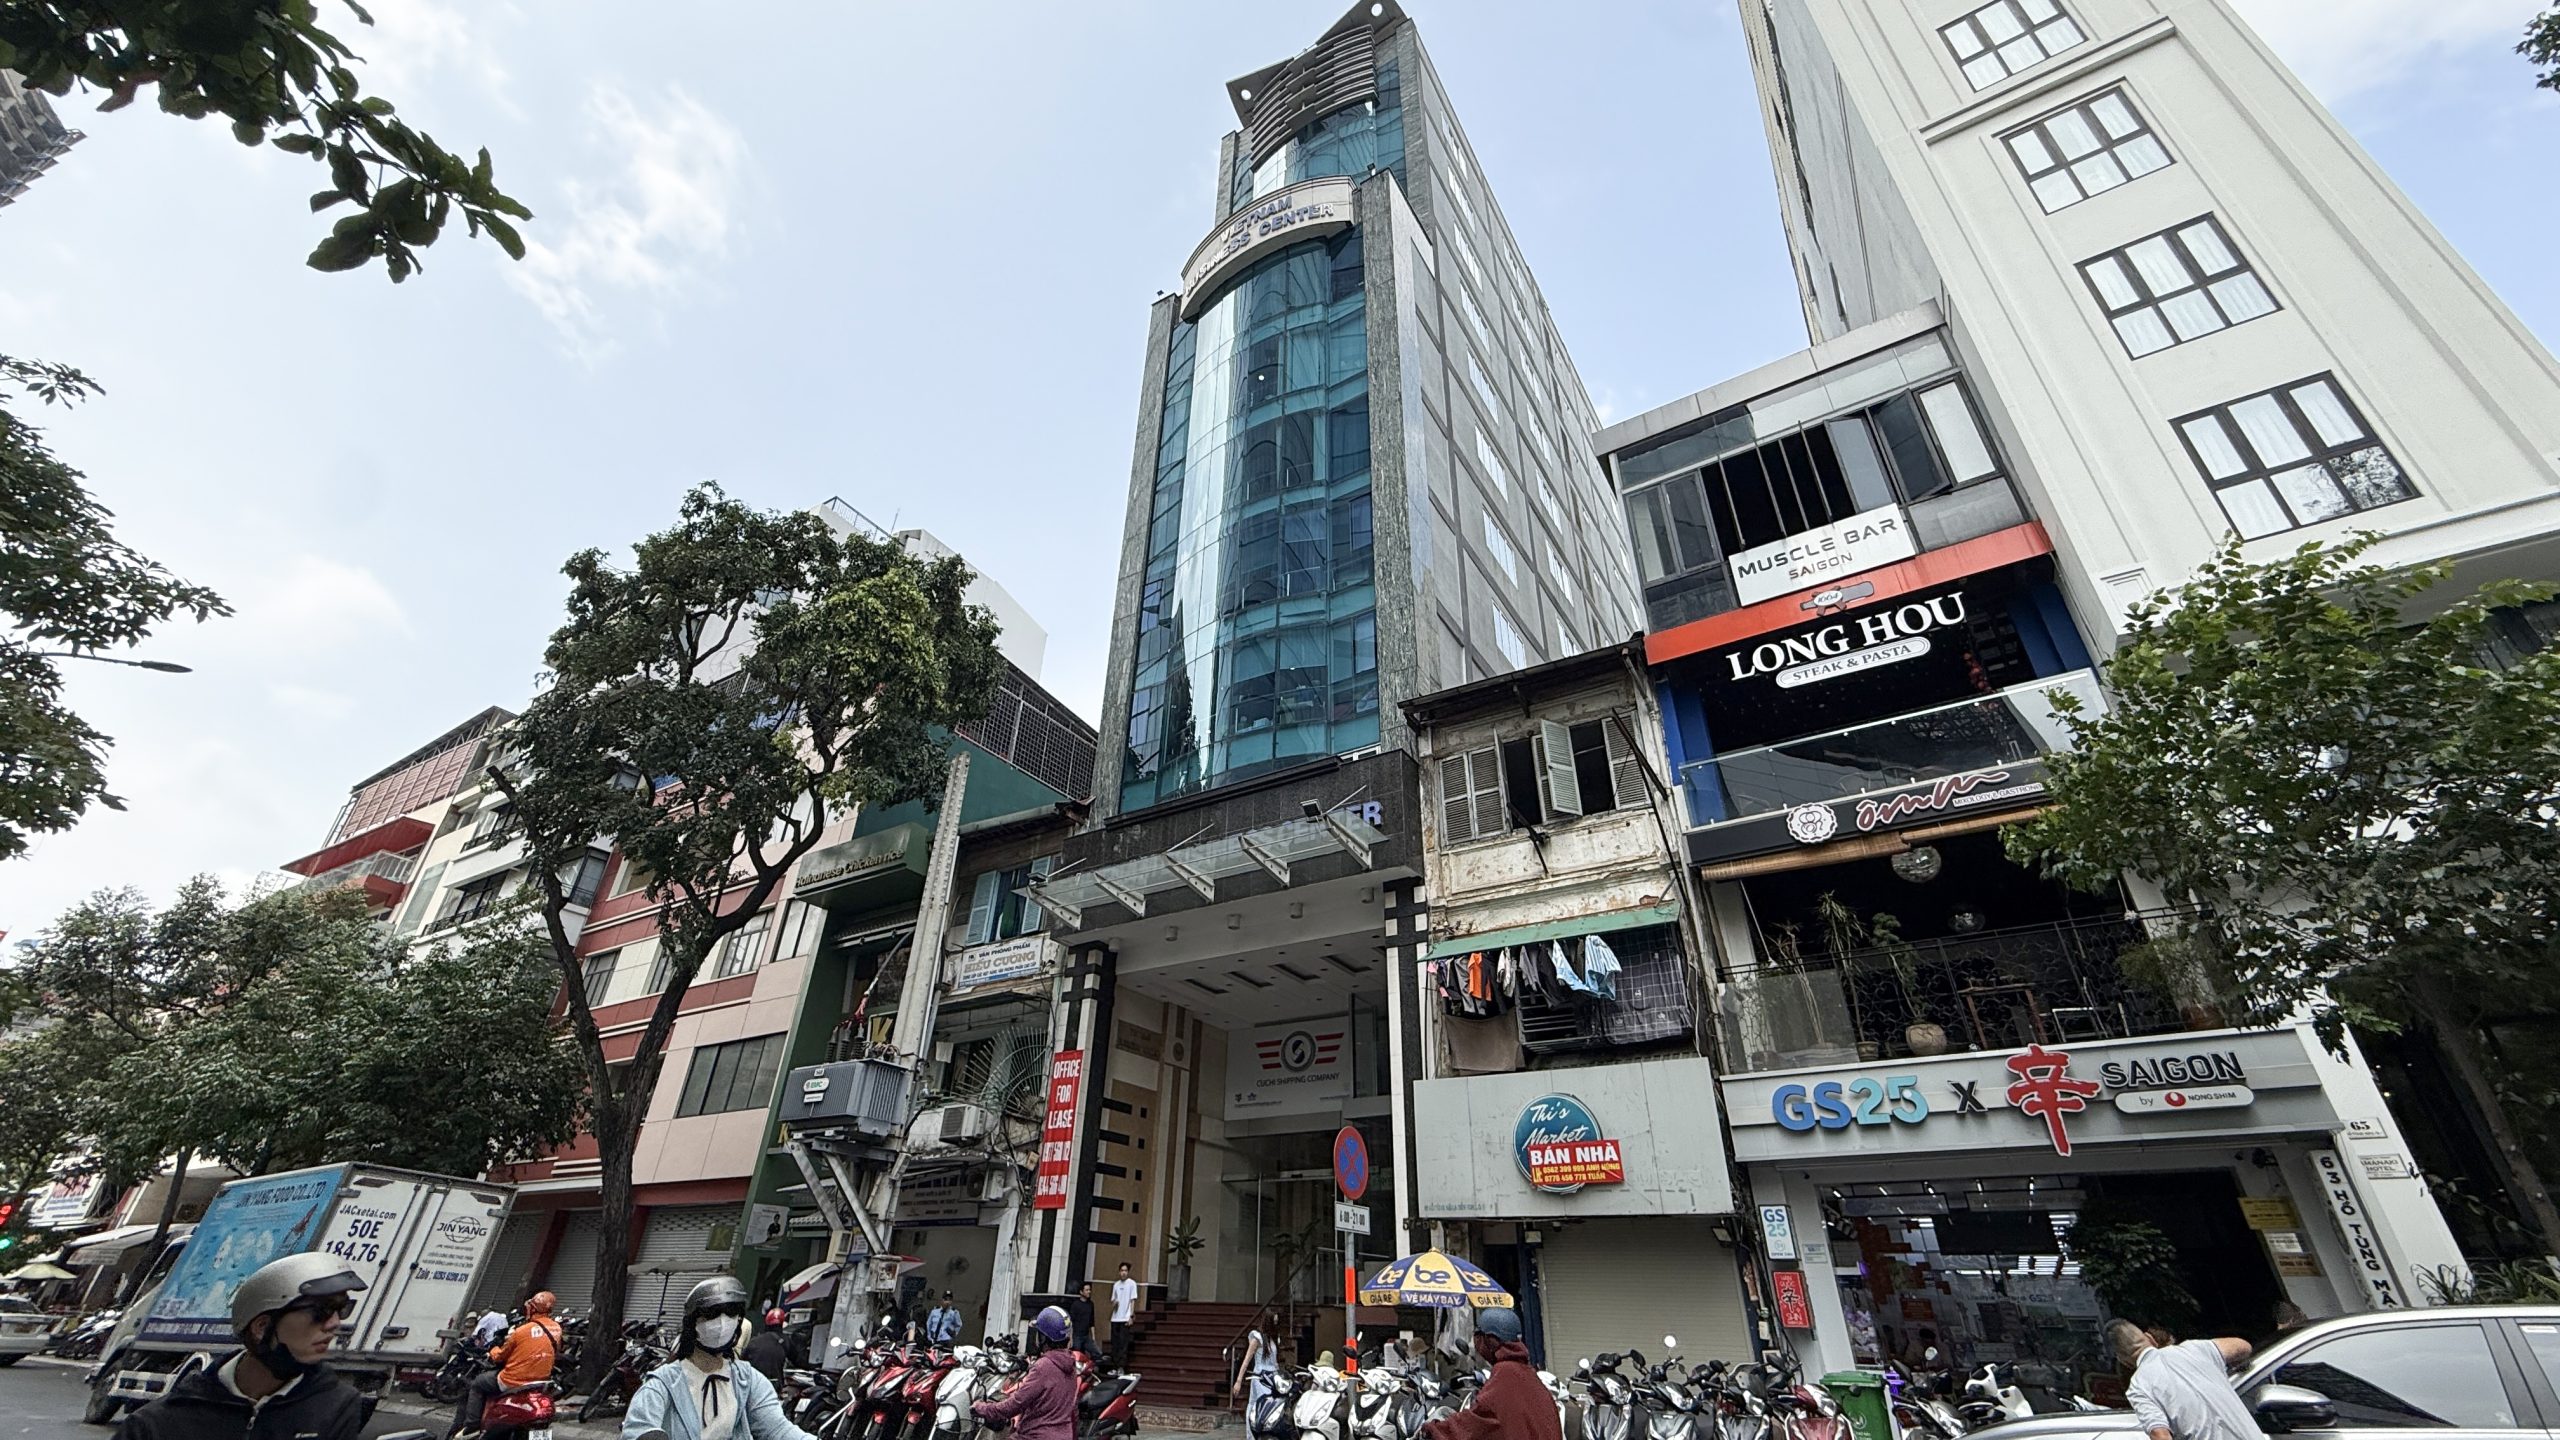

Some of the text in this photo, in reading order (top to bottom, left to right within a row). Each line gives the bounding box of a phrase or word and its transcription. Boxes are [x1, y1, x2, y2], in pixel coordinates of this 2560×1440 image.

[1219, 195, 1293, 244] VIETNAM
[1258, 202, 1334, 237] CENTER
[1738, 517, 1898, 579] MUSCLE BAR
[1788, 552, 1853, 580] SAIGON
[1725, 591, 1966, 681] LONG HOU
[1792, 643, 1912, 682] STEAK & PASTA
[883, 848, 905, 863] rice
[1054, 1059, 1081, 1079] OFFICE
[2101, 1051, 2246, 1088] SAIGON
[1256, 1072, 1340, 1088] CUCHI SHIPPING COMPANY
[1056, 1084, 1072, 1103] FOR
[1772, 1075, 1929, 1131] GS25
[2006, 1043, 2101, 1157] 辛
[2138, 1096, 2154, 1107] by
[1048, 1109, 1074, 1129] LEASE
[2350, 1121, 2370, 1130] 65
[1522, 1124, 1589, 1151] Market
[1530, 1142, 1619, 1166] BÁN NHÀ
[1763, 1209, 1785, 1223] GS
[347, 1219, 384, 1239] 50E
[436, 1222, 488, 1237] JIN YANG
[1767, 1223, 1787, 1237] 25
[2319, 1156, 2342, 1185] 63
[2371, 1279, 2398, 1308] MẬ
[1377, 1265, 1405, 1284] be
[1415, 1265, 1450, 1284] be
[1455, 1265, 1492, 1287] be
